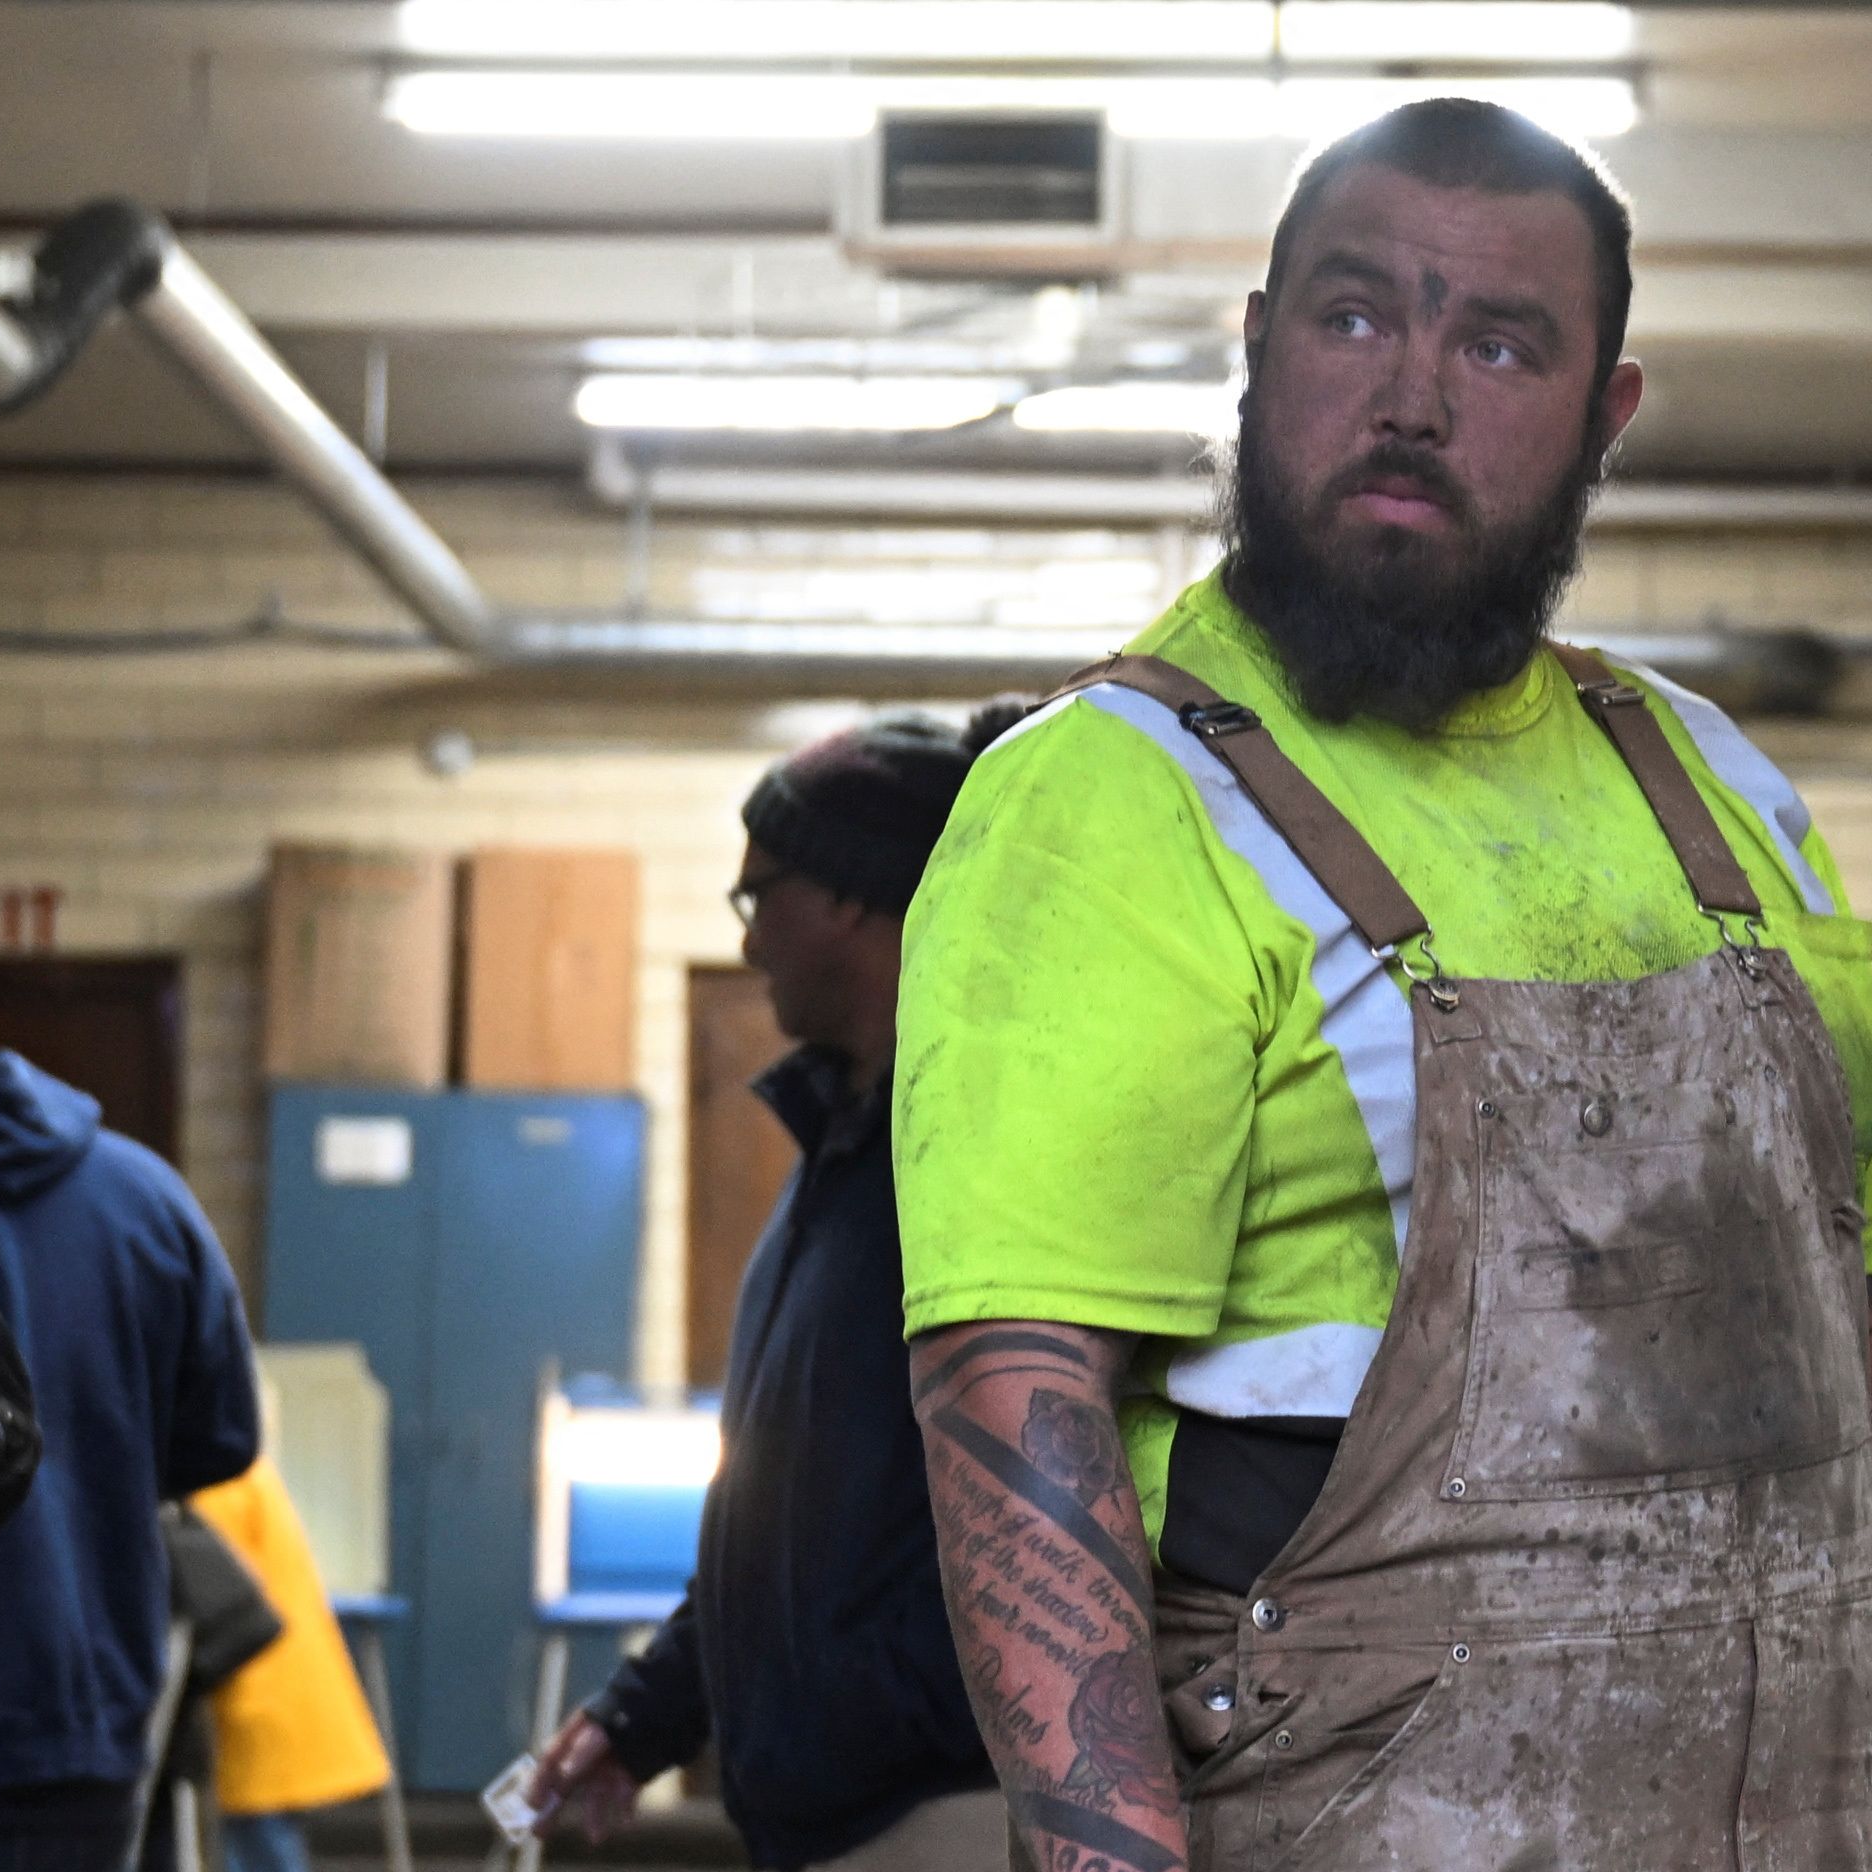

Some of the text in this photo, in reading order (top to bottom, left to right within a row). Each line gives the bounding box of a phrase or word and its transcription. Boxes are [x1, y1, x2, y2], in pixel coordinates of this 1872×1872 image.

[991, 1545, 1025, 1583] the
[1022, 1576, 1109, 1643] shadow
[1023, 1532, 1085, 1583] walk
